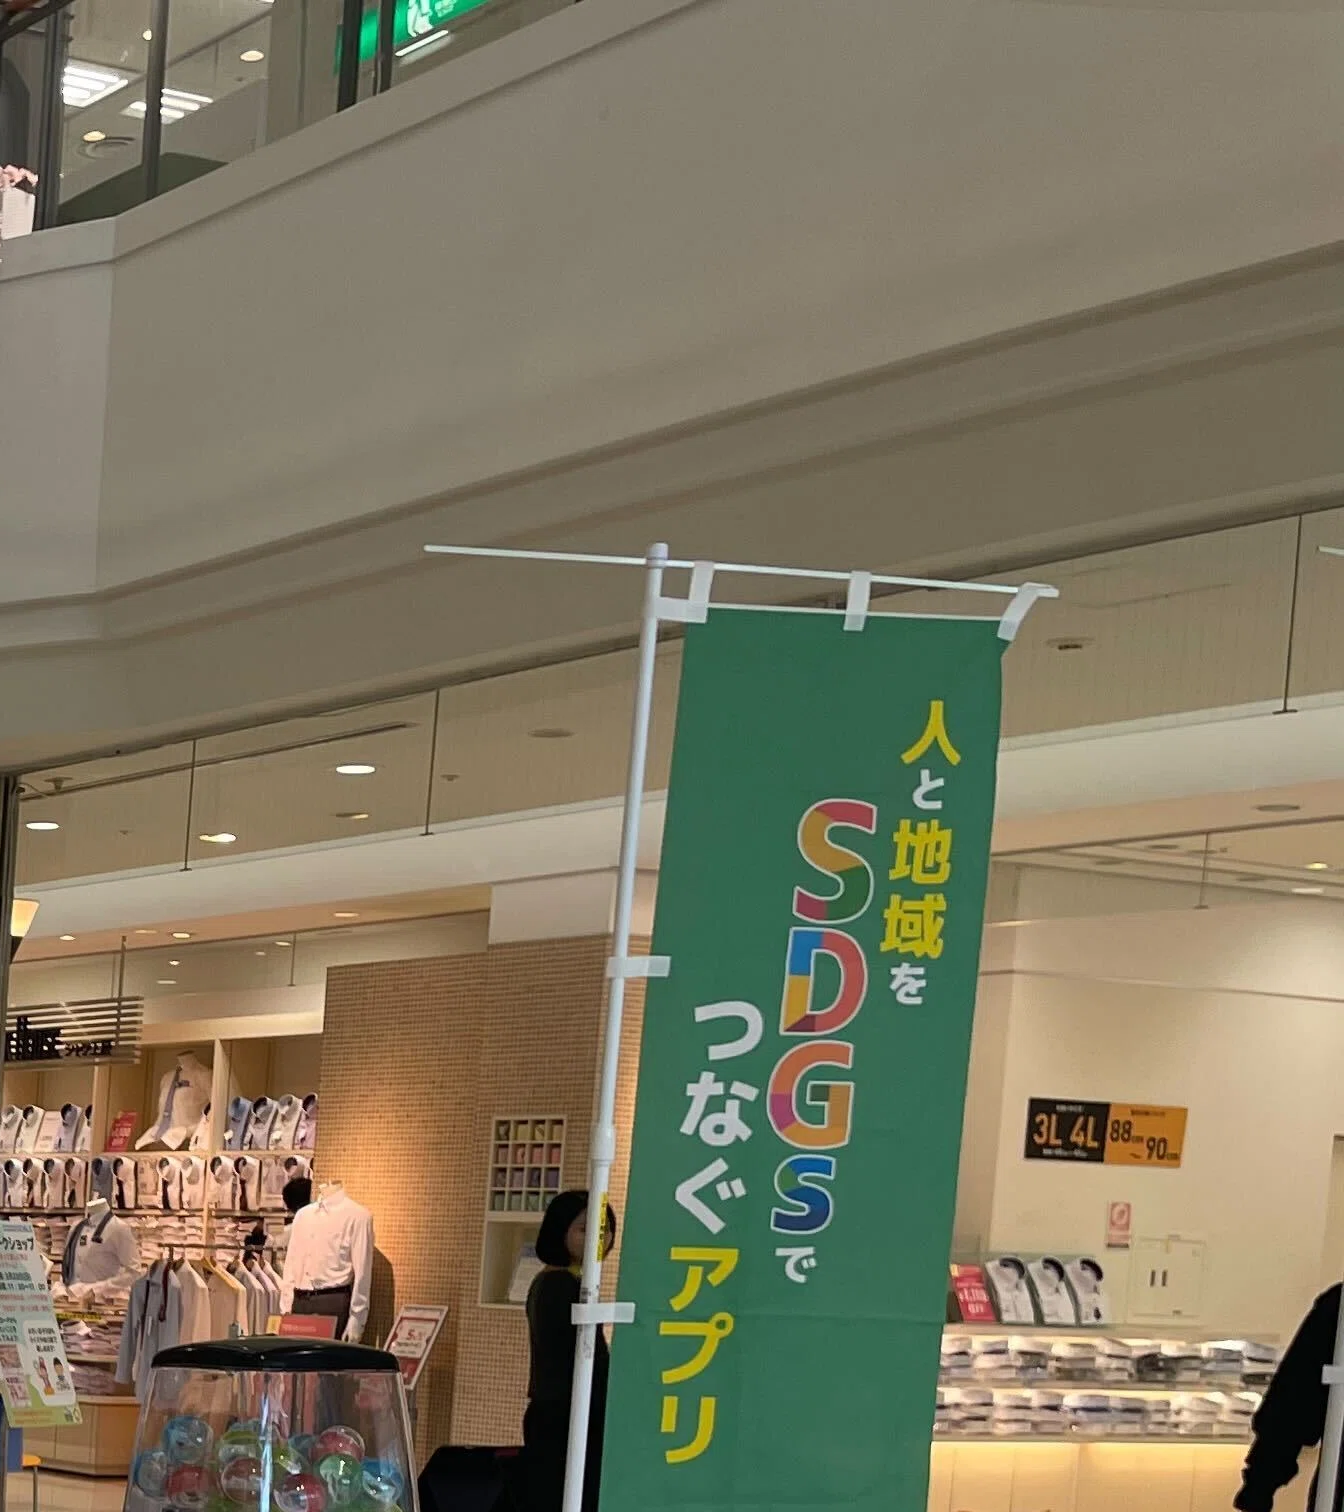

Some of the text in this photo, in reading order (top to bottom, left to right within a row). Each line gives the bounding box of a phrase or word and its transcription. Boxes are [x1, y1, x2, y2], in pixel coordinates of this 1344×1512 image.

[767, 797, 879, 1285] SDGsで
[880, 699, 961, 1006] 人と地域を
[659, 999, 764, 1465] つなぐアプリ
[1033, 1112, 1099, 1148] 3L 4L
